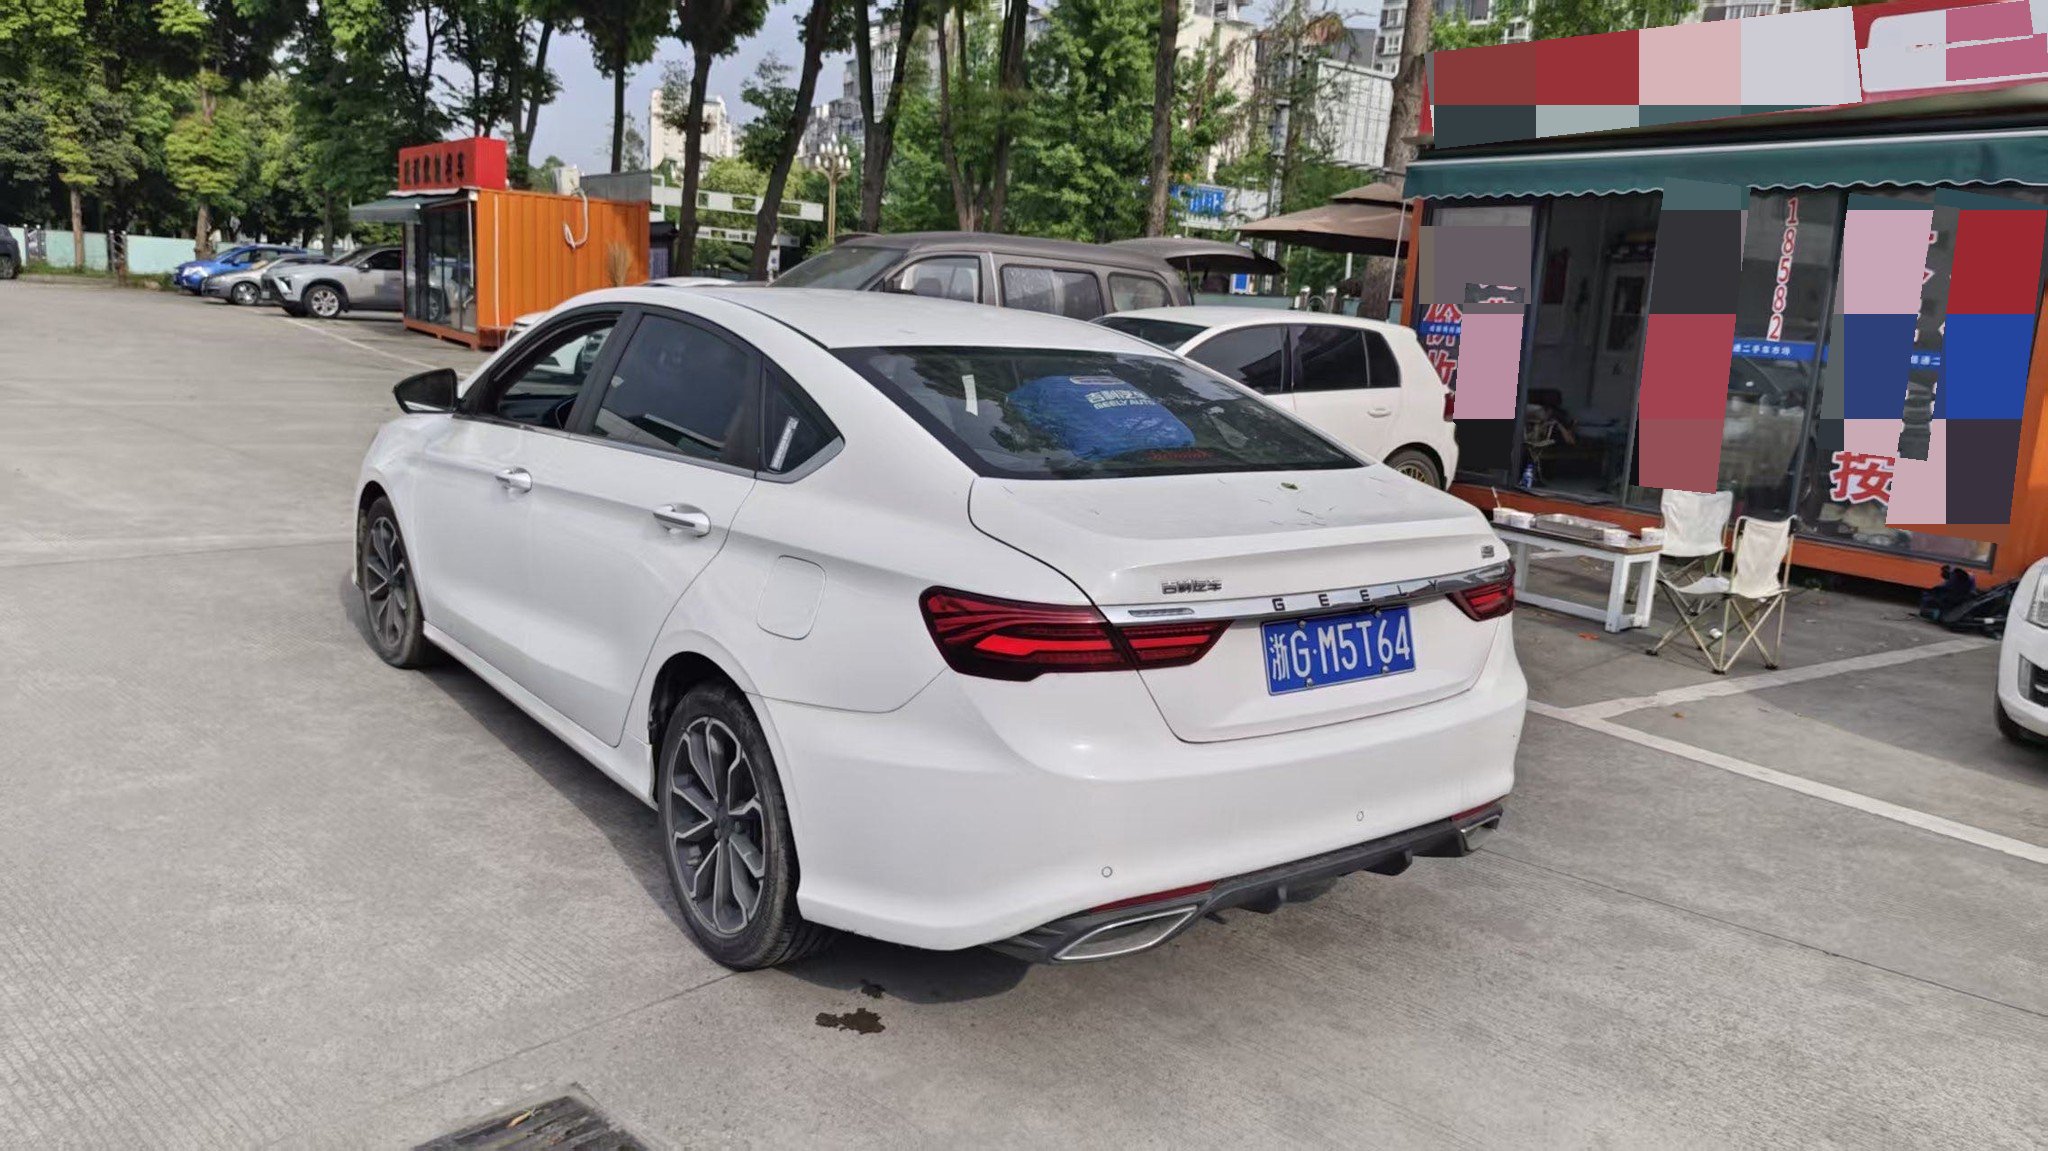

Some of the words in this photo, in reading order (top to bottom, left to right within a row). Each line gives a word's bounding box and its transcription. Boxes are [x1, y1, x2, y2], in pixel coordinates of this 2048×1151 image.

[1766, 197, 1798, 341] 18582
[1093, 399, 1128, 410] GEELY
[1271, 579, 1438, 612] GEELY
